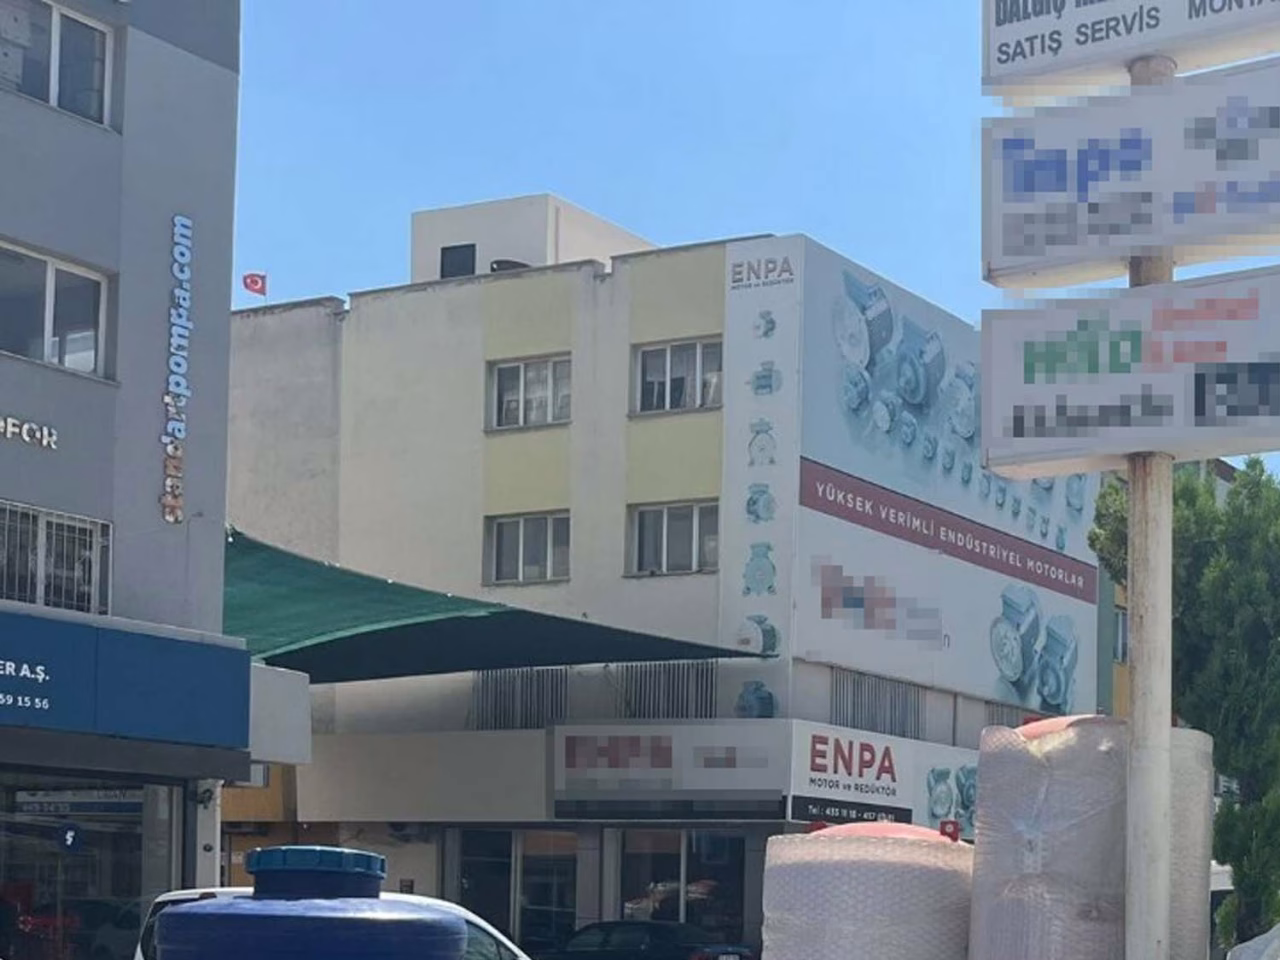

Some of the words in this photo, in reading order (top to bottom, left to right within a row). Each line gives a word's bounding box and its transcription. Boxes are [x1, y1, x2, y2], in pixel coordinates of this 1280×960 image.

[997, 30, 1062, 64] SATIŞ
[1075, 5, 1160, 46] SERVİS
[731, 256, 794, 284] ENPA
[816, 480, 873, 516] YÜKSEK
[879, 503, 935, 537] VERİMLİ
[939, 526, 1023, 568] ENDÜSTRİYEL
[1026, 557, 1085, 589] MOTORLAR
[19, 663, 50, 683] A.Ş.
[17, 696, 31, 707] 15
[34, 697, 50, 710] 56
[810, 734, 897, 783] ENPA
[808, 777, 840, 790] MOTOR
